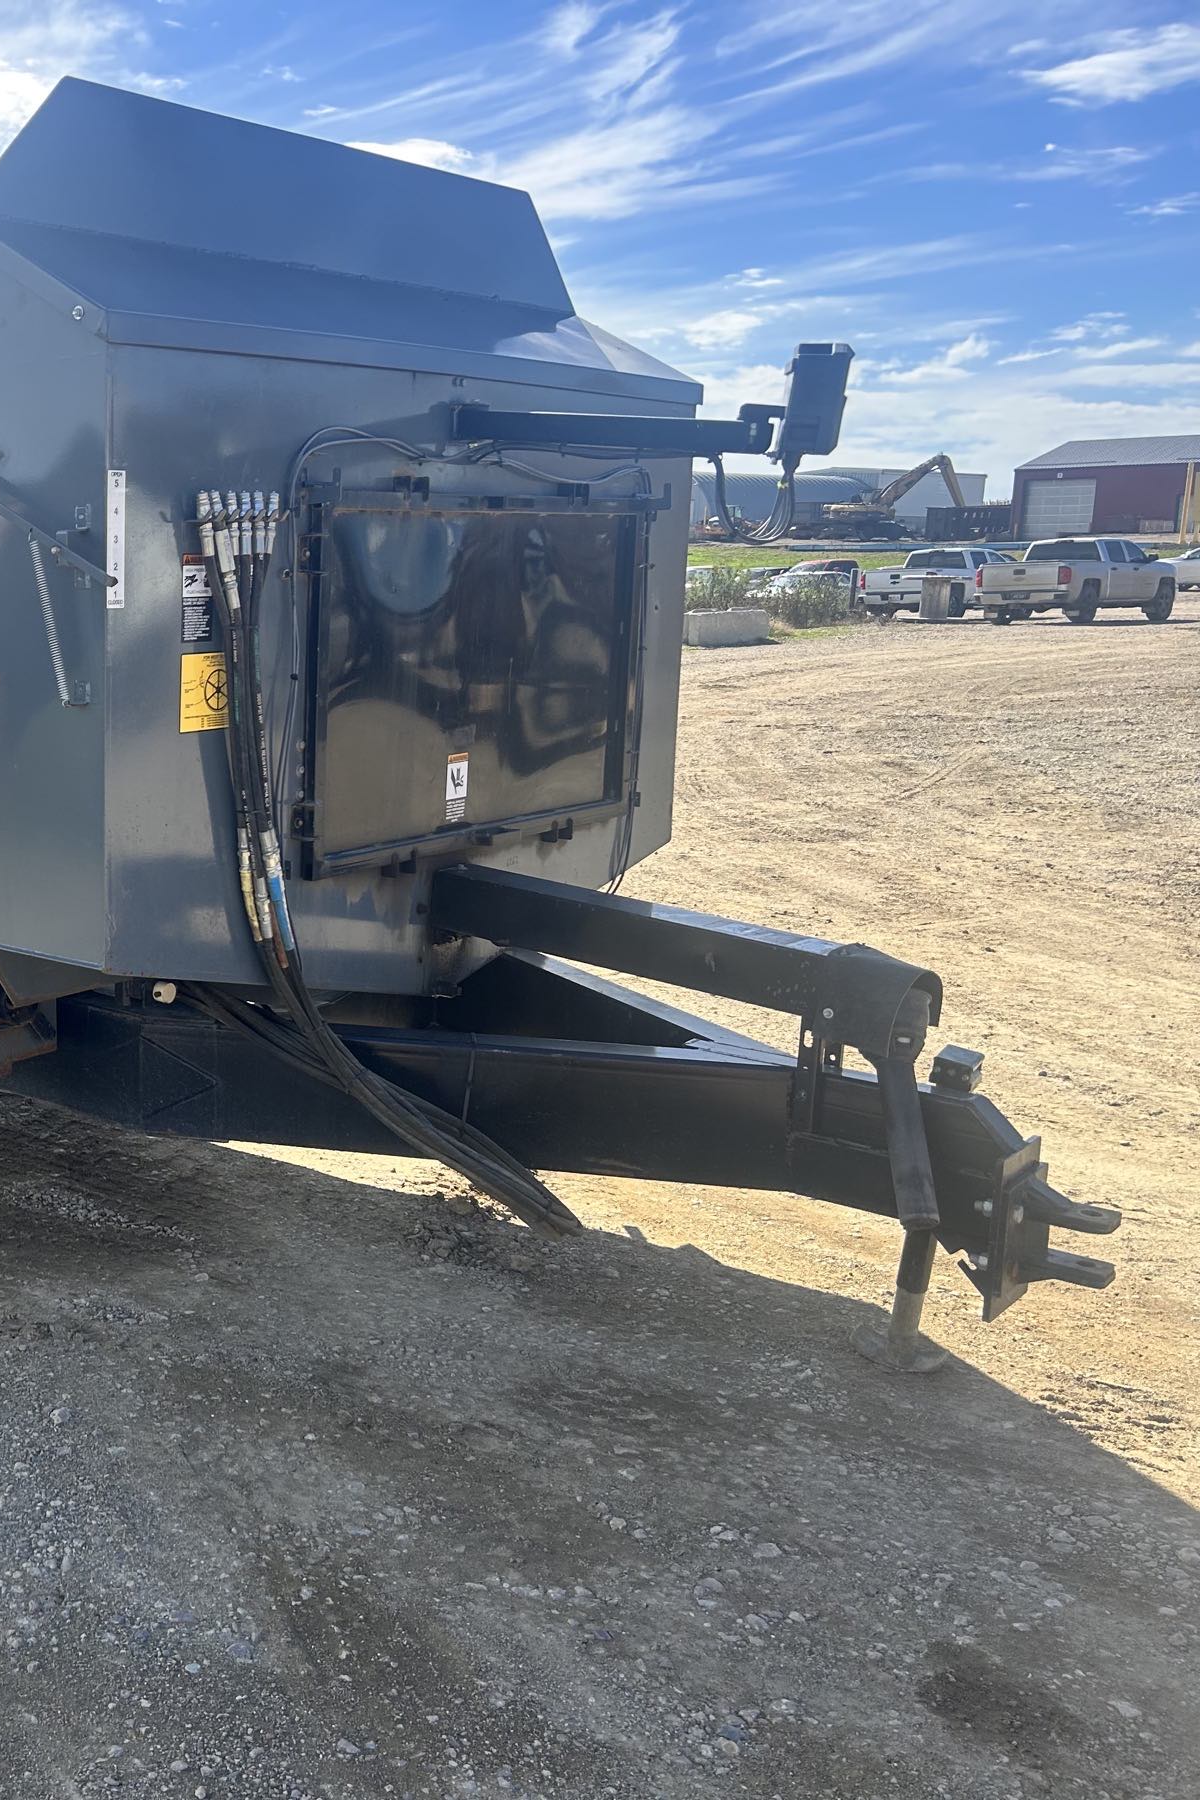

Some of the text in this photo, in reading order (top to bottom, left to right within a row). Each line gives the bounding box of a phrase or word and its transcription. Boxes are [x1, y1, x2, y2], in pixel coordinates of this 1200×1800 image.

[114, 480, 119, 488] 5
[113, 507, 119, 516] 4
[113, 535, 119, 544] 3
[113, 563, 119, 571] 2
[113, 591, 118, 599] 1
